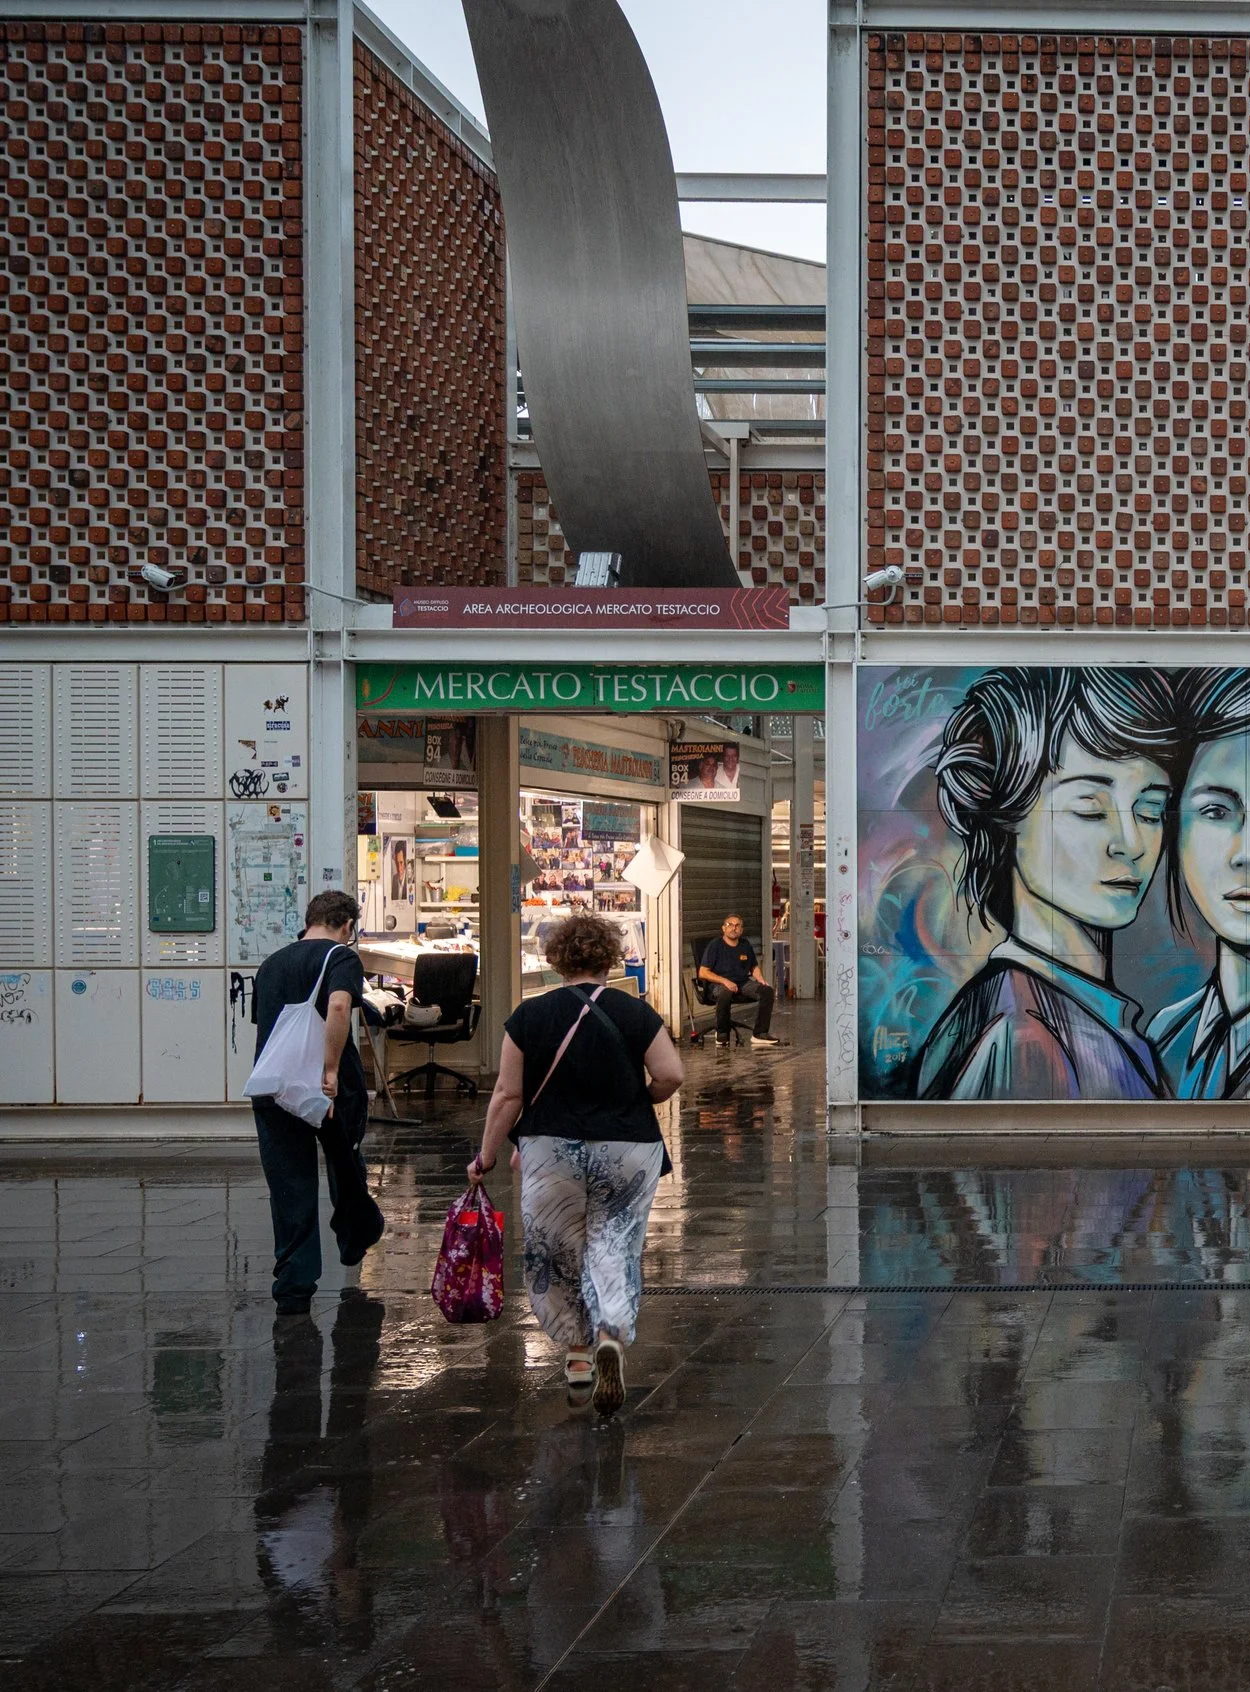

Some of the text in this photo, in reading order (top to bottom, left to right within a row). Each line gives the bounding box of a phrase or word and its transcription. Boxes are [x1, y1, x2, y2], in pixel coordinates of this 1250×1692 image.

[463, 603, 720, 616] AREA ARCHEOLOGICA MERCATO TESTACCIO
[414, 672, 779, 702] MERCATO TESTACCIO
[865, 677, 944, 731] forte
[427, 735, 441, 745] BOX
[426, 745, 441, 762] 94
[671, 744, 724, 753] MASTROIANNI
[671, 764, 689, 772] BOX
[671, 771, 689, 785] 94
[671, 791, 738, 801] CONSEGNE A DOMICILIO
[885, 1052, 907, 1063] 2017
